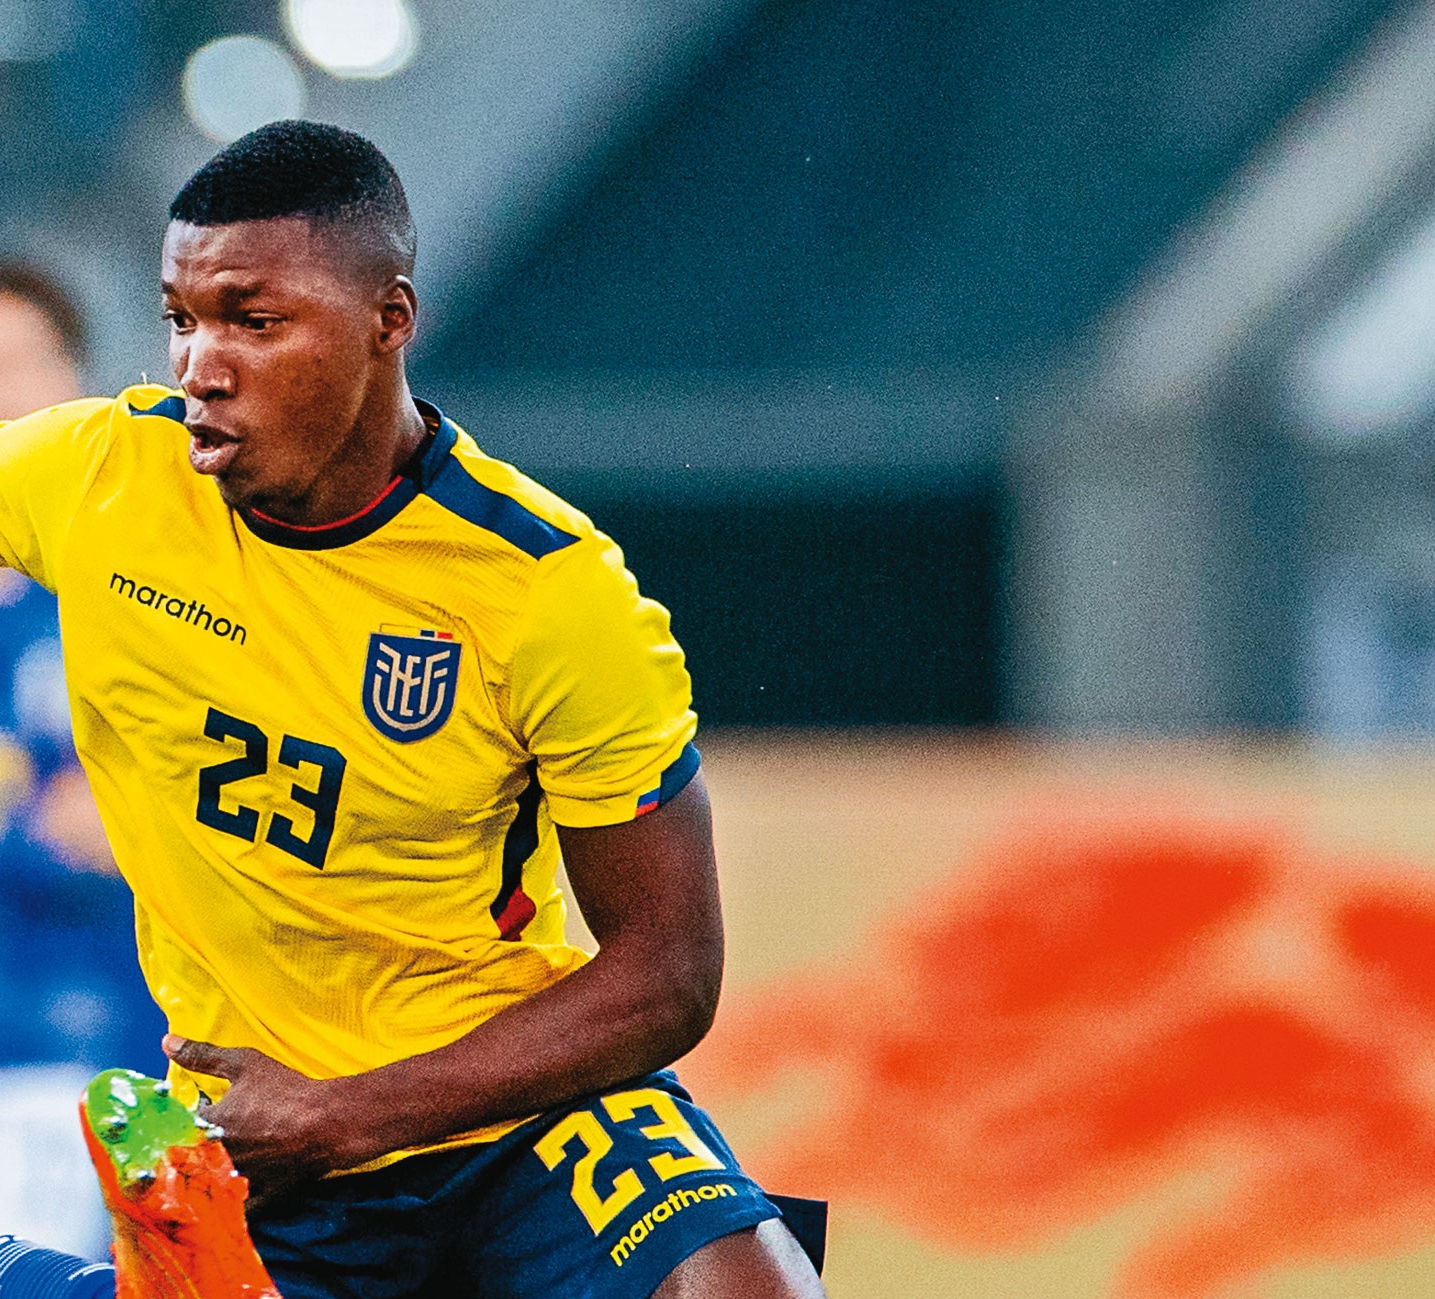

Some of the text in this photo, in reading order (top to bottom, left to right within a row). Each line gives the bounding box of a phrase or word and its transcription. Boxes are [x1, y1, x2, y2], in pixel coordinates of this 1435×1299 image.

[110, 572, 247, 646] marathon
[196, 707, 347, 870] 23
[533, 1088, 726, 1237] 23
[609, 1183, 737, 1267] marathon
